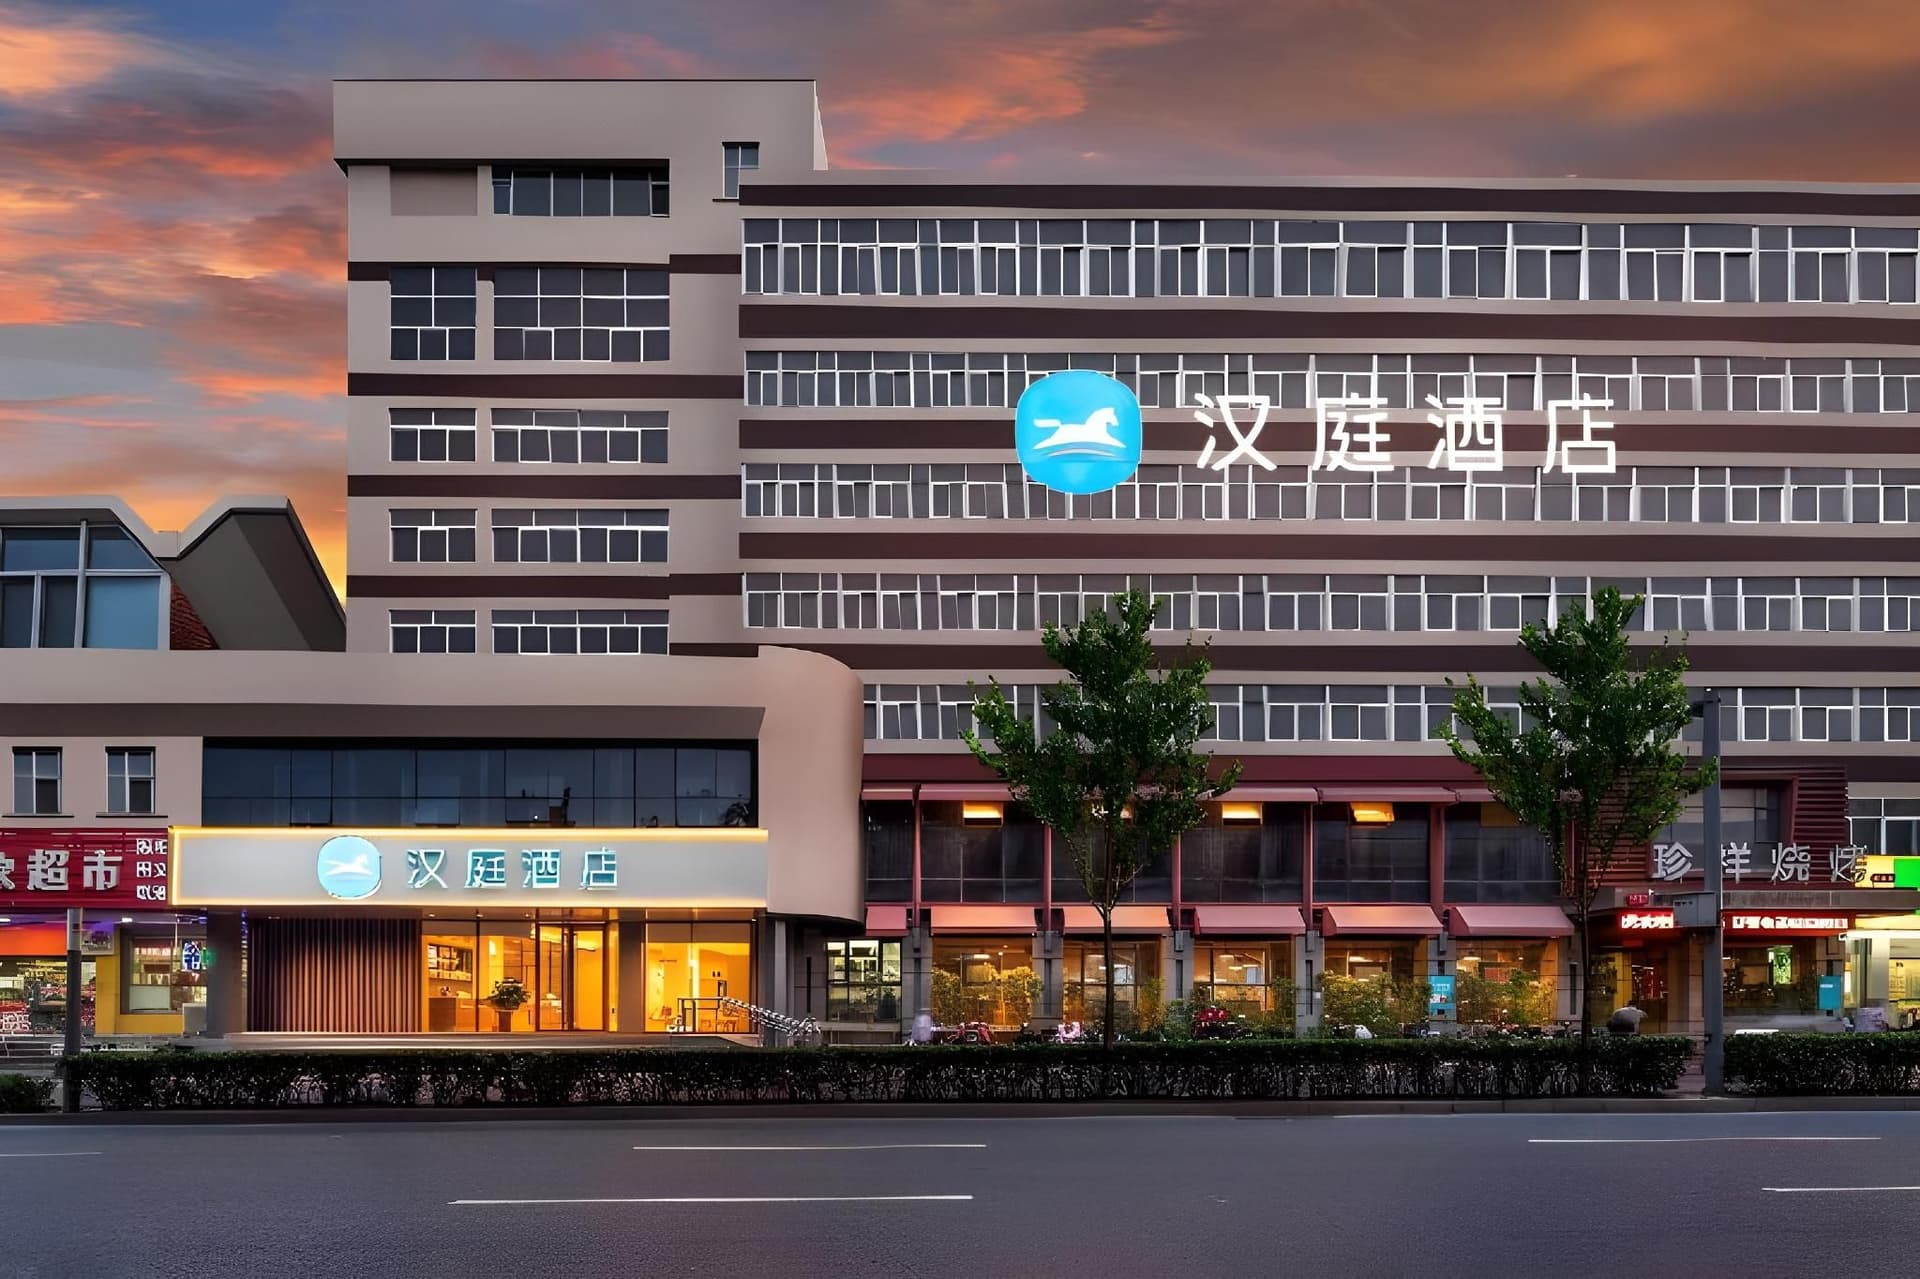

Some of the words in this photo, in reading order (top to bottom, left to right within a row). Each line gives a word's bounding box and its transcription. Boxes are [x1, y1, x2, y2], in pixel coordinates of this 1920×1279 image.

[1194, 392, 1616, 474] 汉庭酒店
[406, 846, 618, 890] 汉庭酒店
